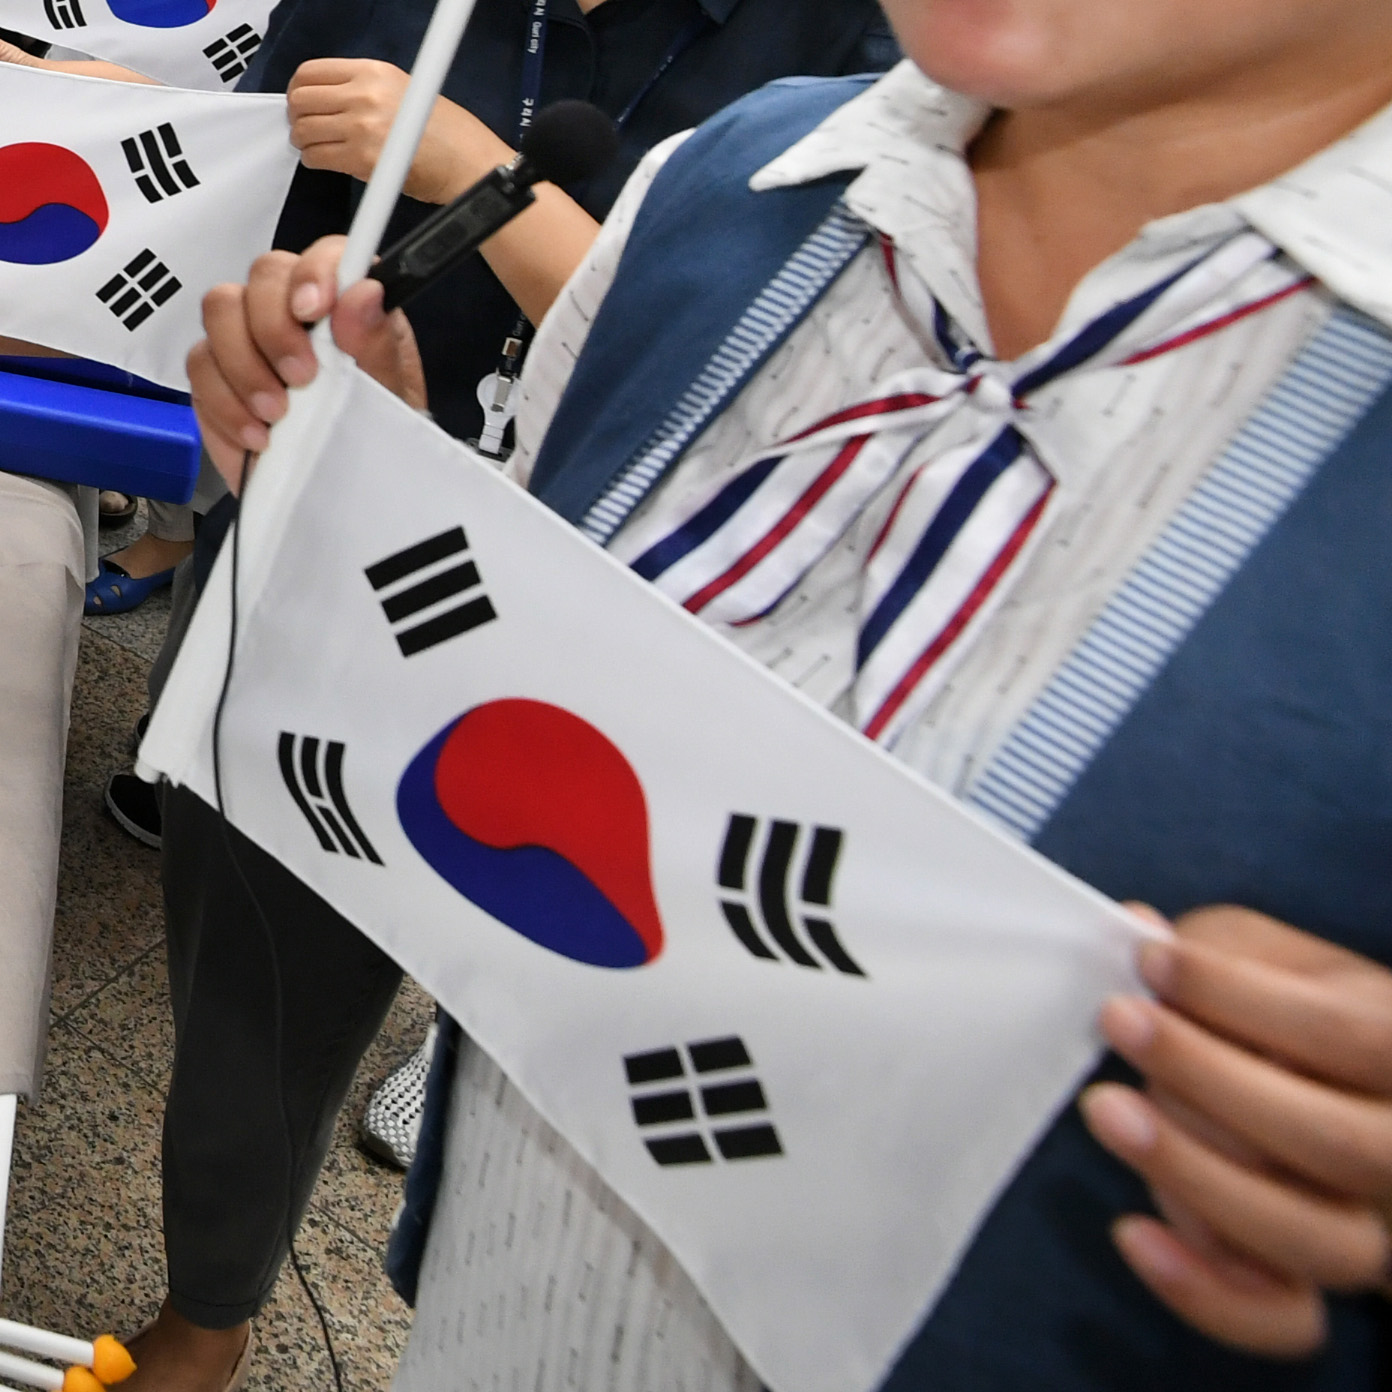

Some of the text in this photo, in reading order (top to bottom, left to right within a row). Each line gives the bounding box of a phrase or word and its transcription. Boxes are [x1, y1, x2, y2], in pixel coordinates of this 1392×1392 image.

[531, 21, 543, 39] Guri
[527, 38, 540, 54] city
[519, 98, 535, 127] 구리시
